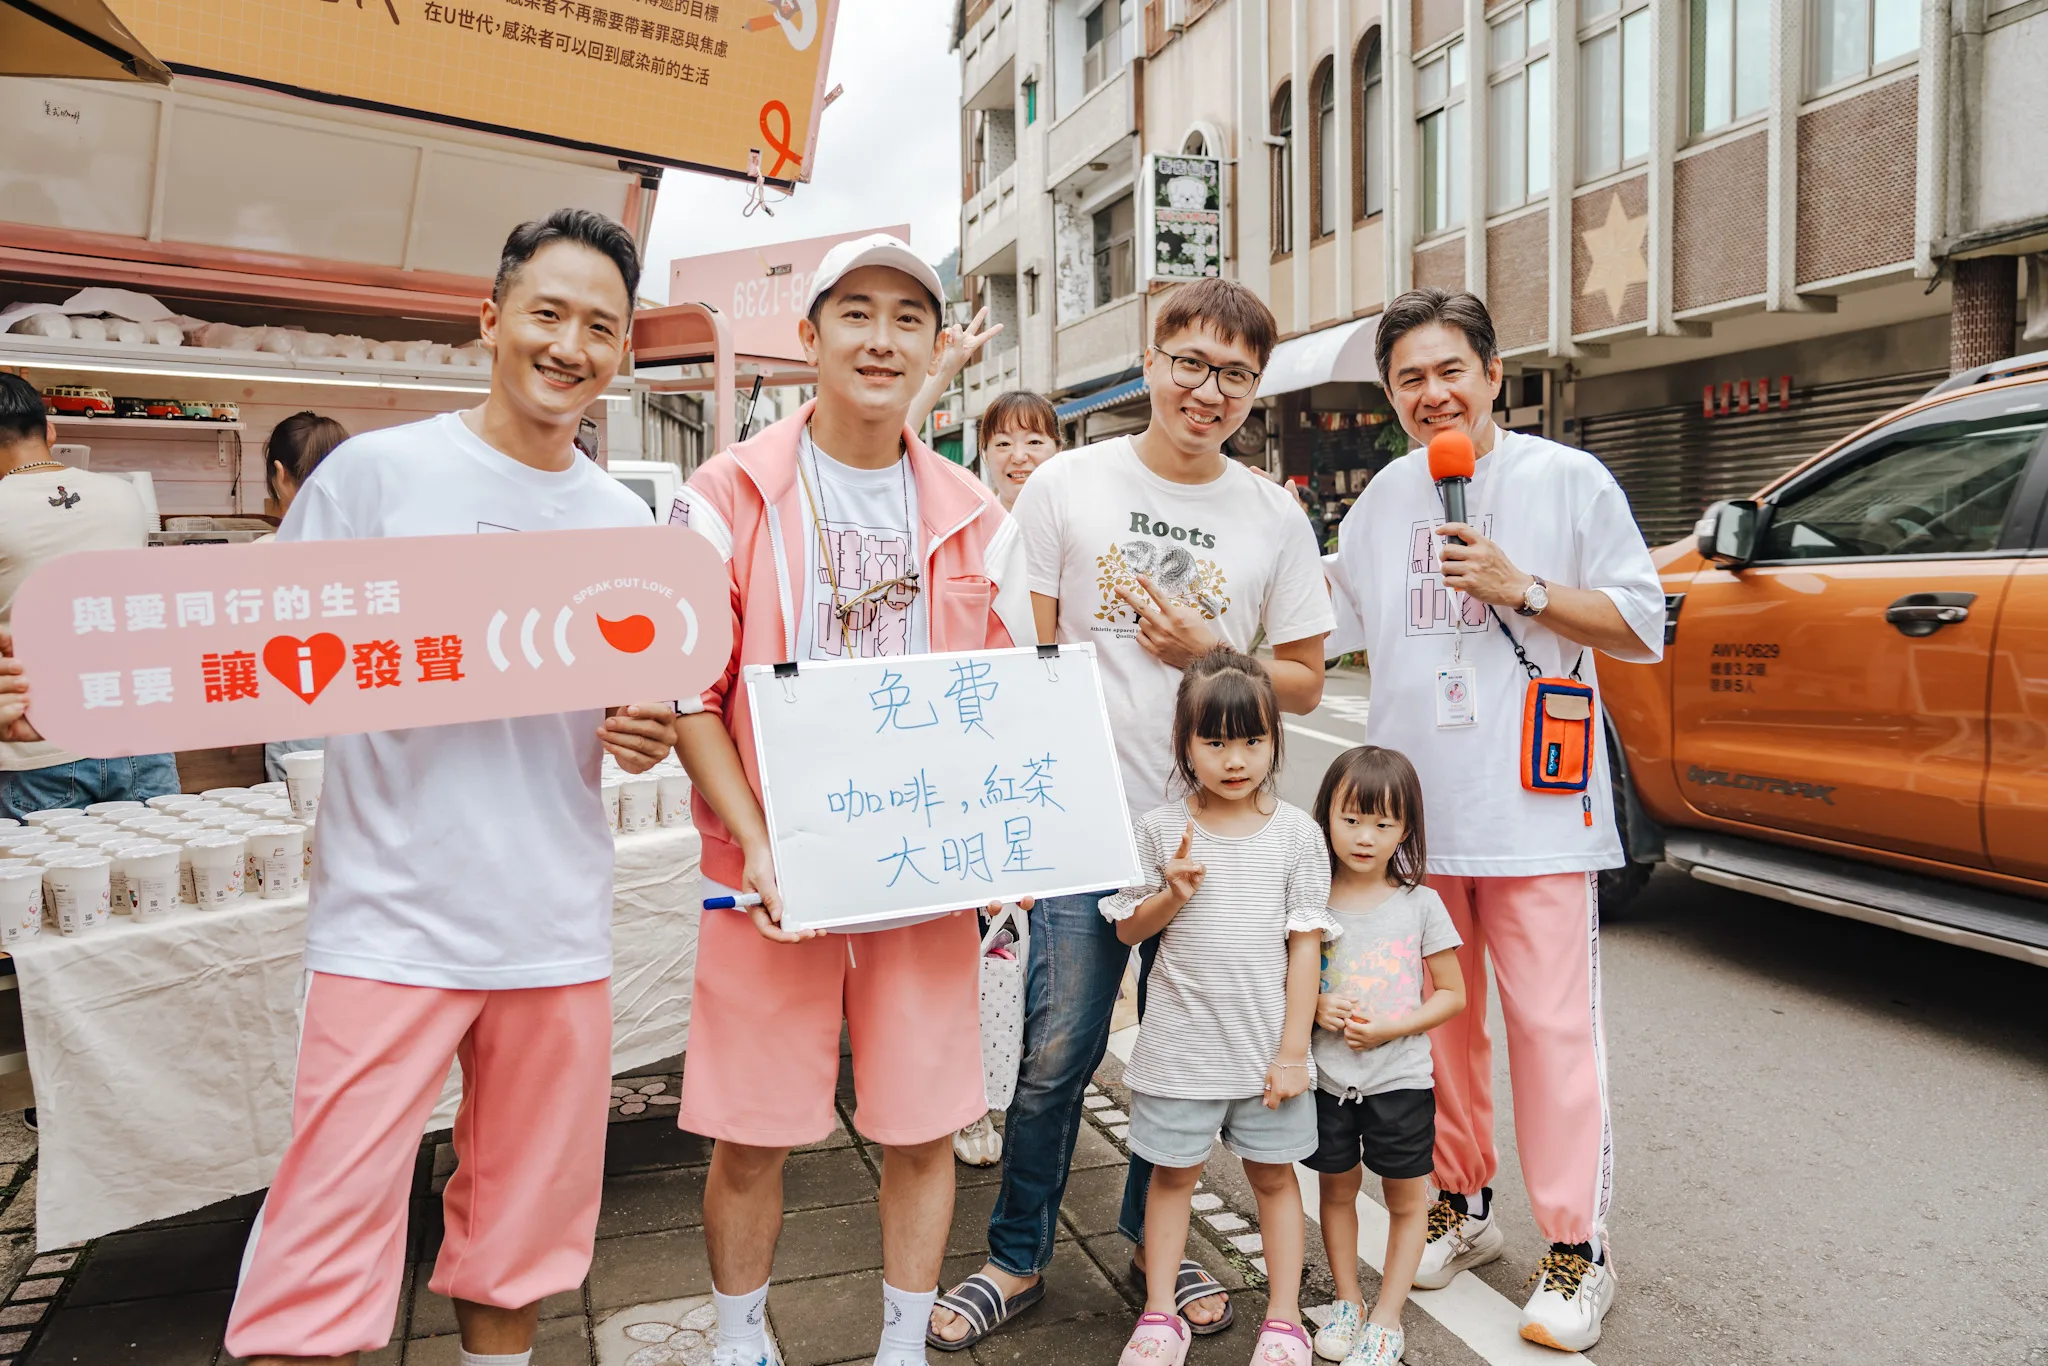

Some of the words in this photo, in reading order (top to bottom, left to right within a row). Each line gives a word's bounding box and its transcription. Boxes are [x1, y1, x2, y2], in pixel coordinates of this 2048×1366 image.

[1129, 511, 1216, 549] Roots
[72, 580, 402, 635] 與愛同行的生活
[573, 580, 612, 604] SPEAK
[614, 578, 640, 588] OUT
[642, 579, 674, 599] LOVE
[79, 667, 175, 709] 更要
[201, 650, 260, 703] 讓
[352, 634, 466, 690] 發聲
[868, 659, 1000, 740] 免費
[876, 815, 1057, 888] 大明星
